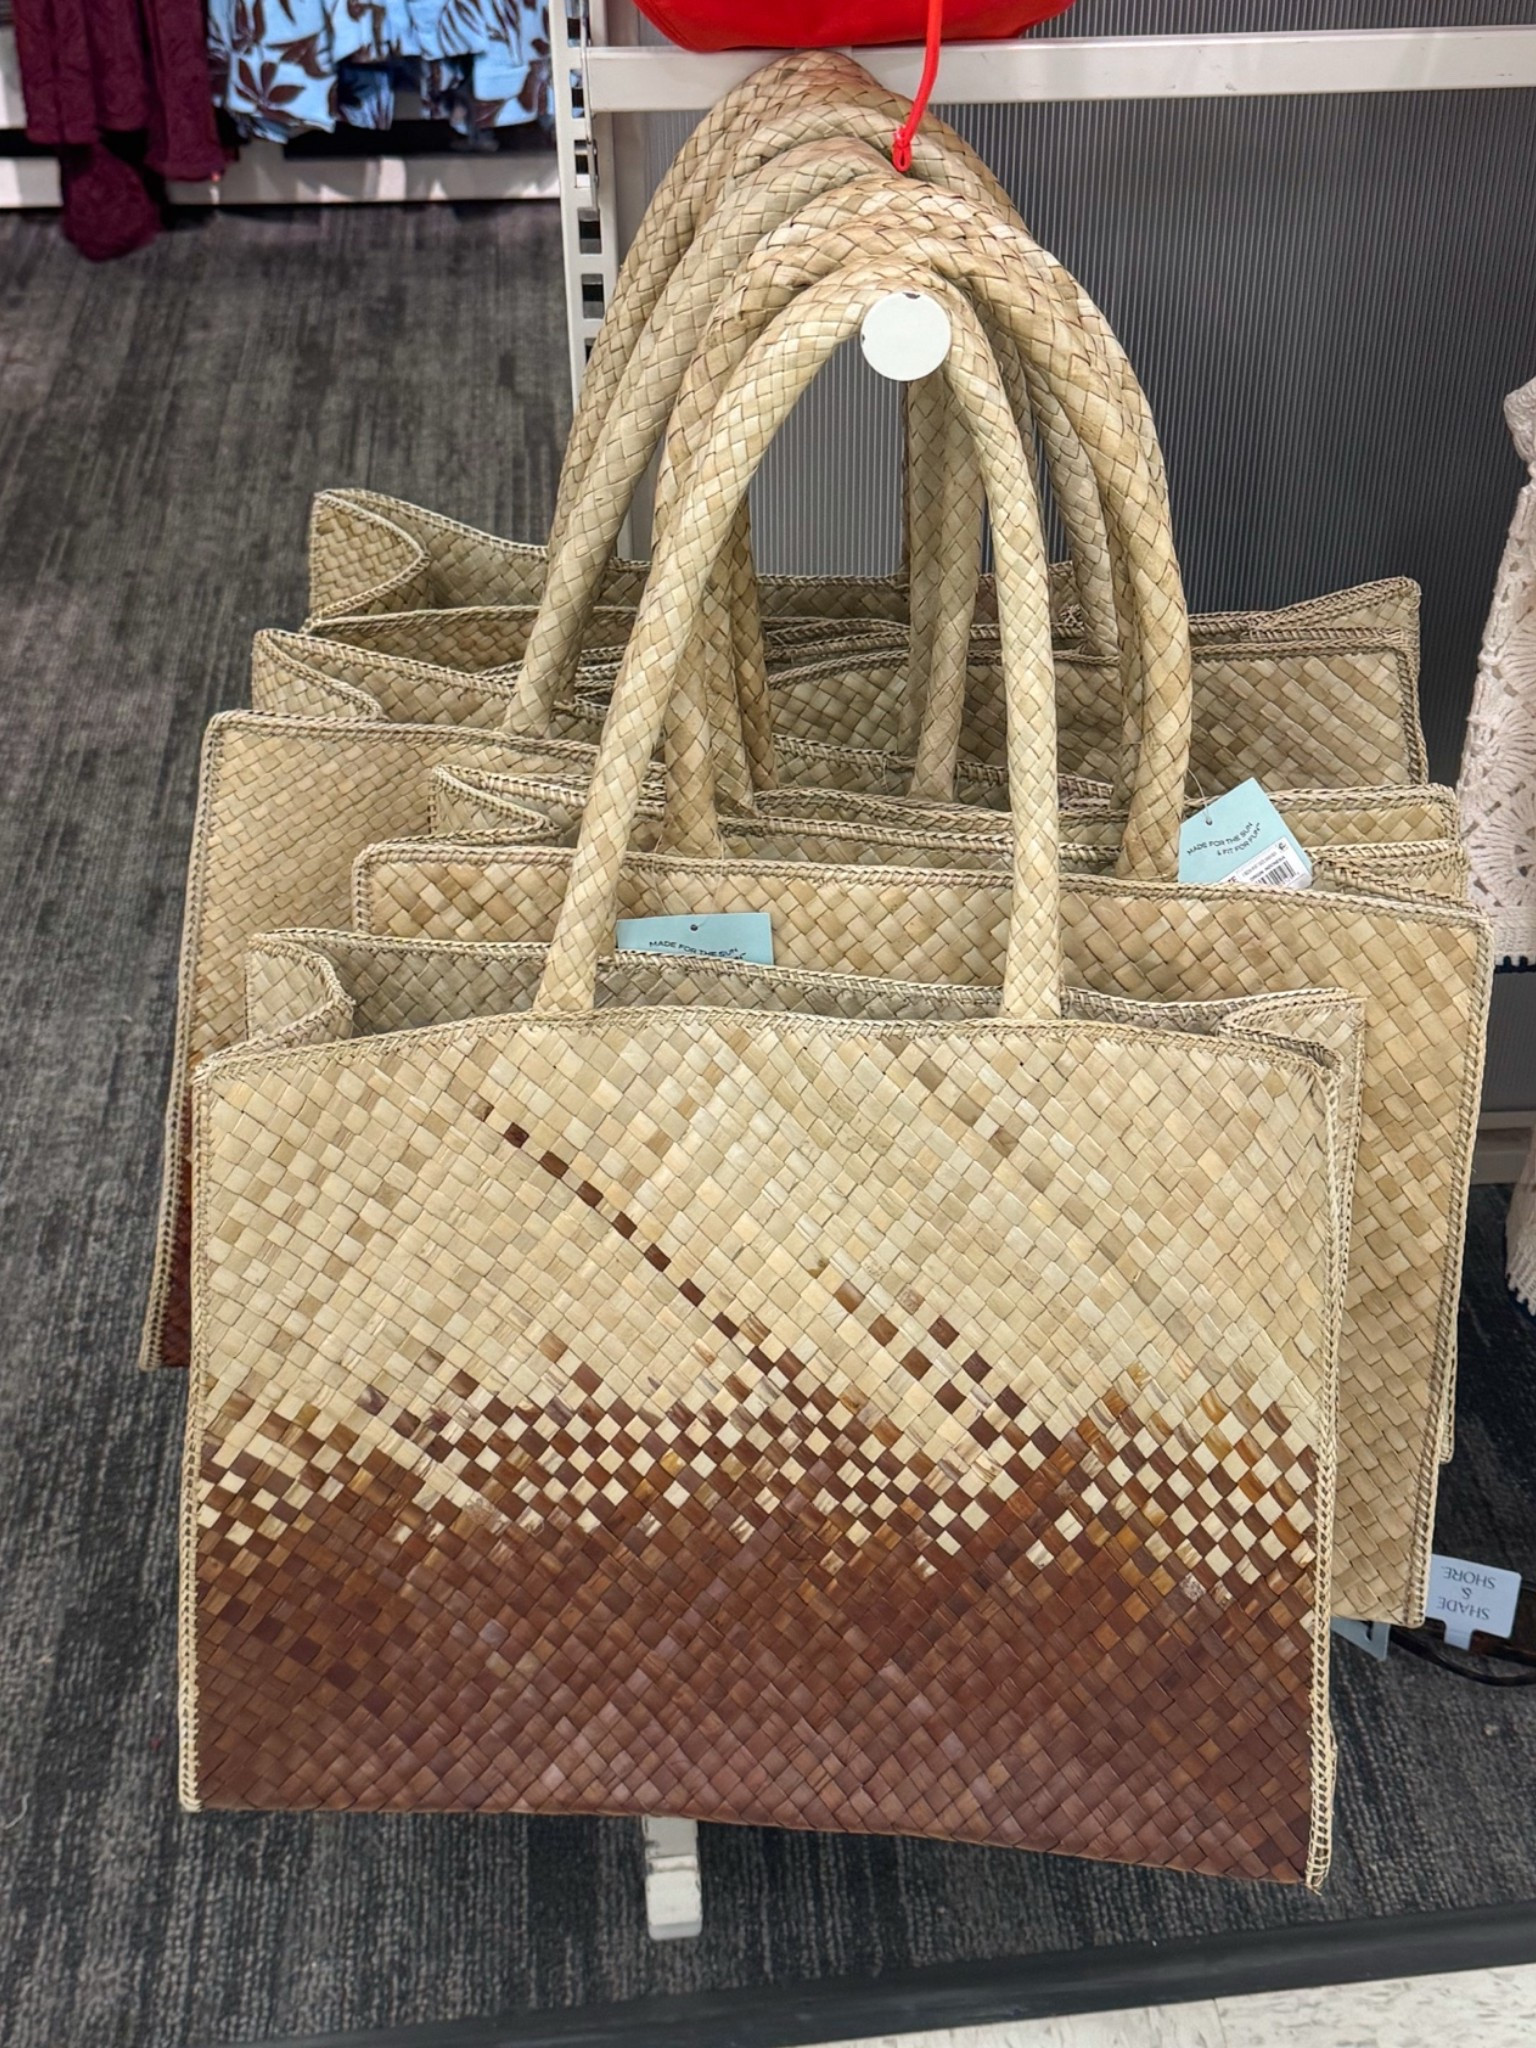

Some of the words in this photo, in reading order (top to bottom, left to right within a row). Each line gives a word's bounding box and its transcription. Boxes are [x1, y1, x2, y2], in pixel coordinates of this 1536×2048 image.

[1186, 842, 1208, 855] MADE
[1226, 834, 1241, 844] THE
[1240, 822, 1253, 837] SUN
[1234, 841, 1250, 851] FOR
[678, 944, 697, 954] FOR
[1443, 1567, 1496, 1590] SHORE
[1461, 1587, 1472, 1599] &
[1437, 1596, 1490, 1620] SHADE
